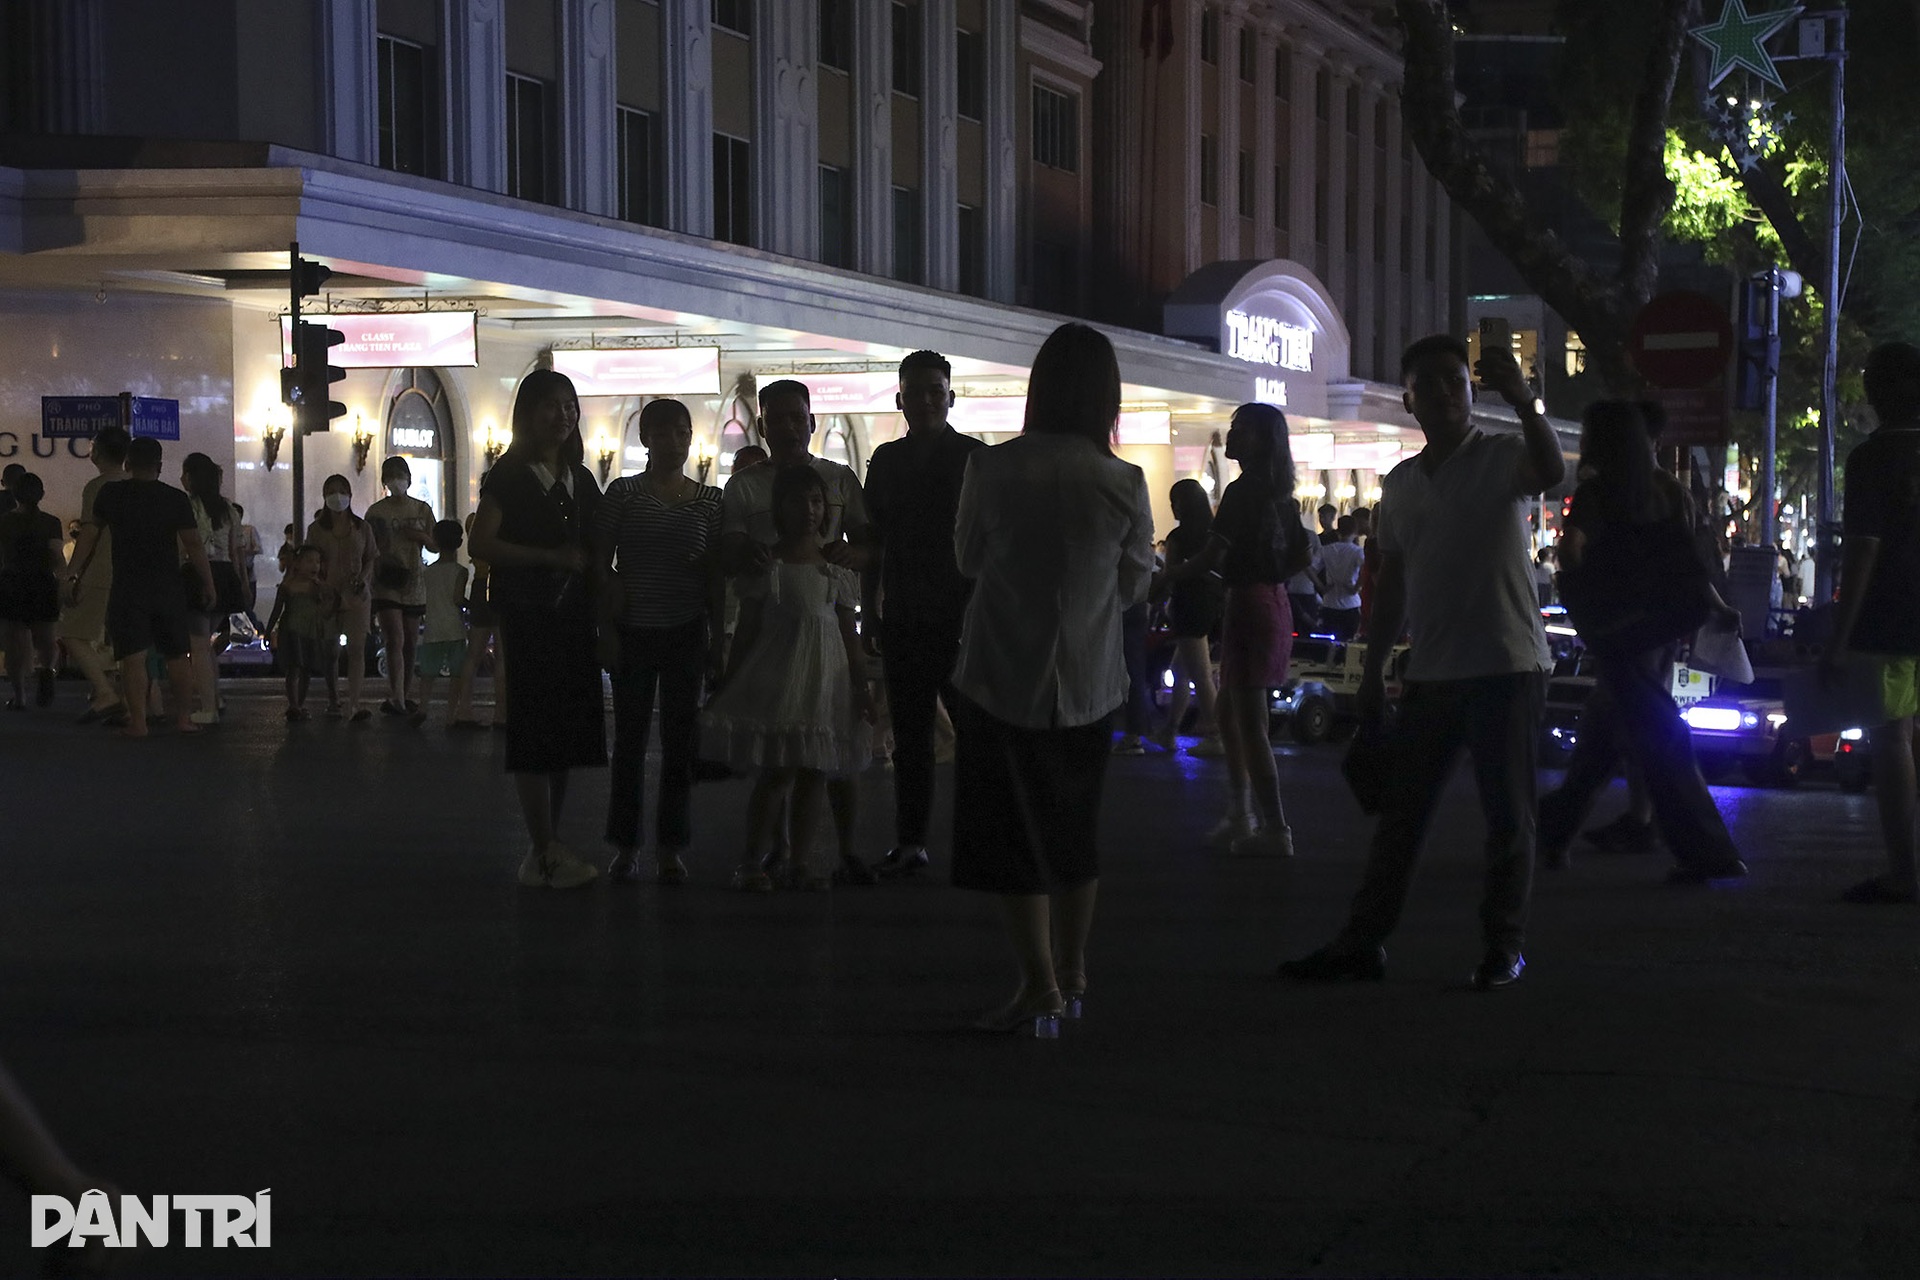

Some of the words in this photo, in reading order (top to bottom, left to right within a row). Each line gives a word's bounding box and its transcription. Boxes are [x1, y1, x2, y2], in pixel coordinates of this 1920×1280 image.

[361, 333, 395, 341] CLASSY
[392, 342, 422, 351] PLAZA
[77, 400, 101, 412] PHỐ
[0, 432, 90, 458] GUC
